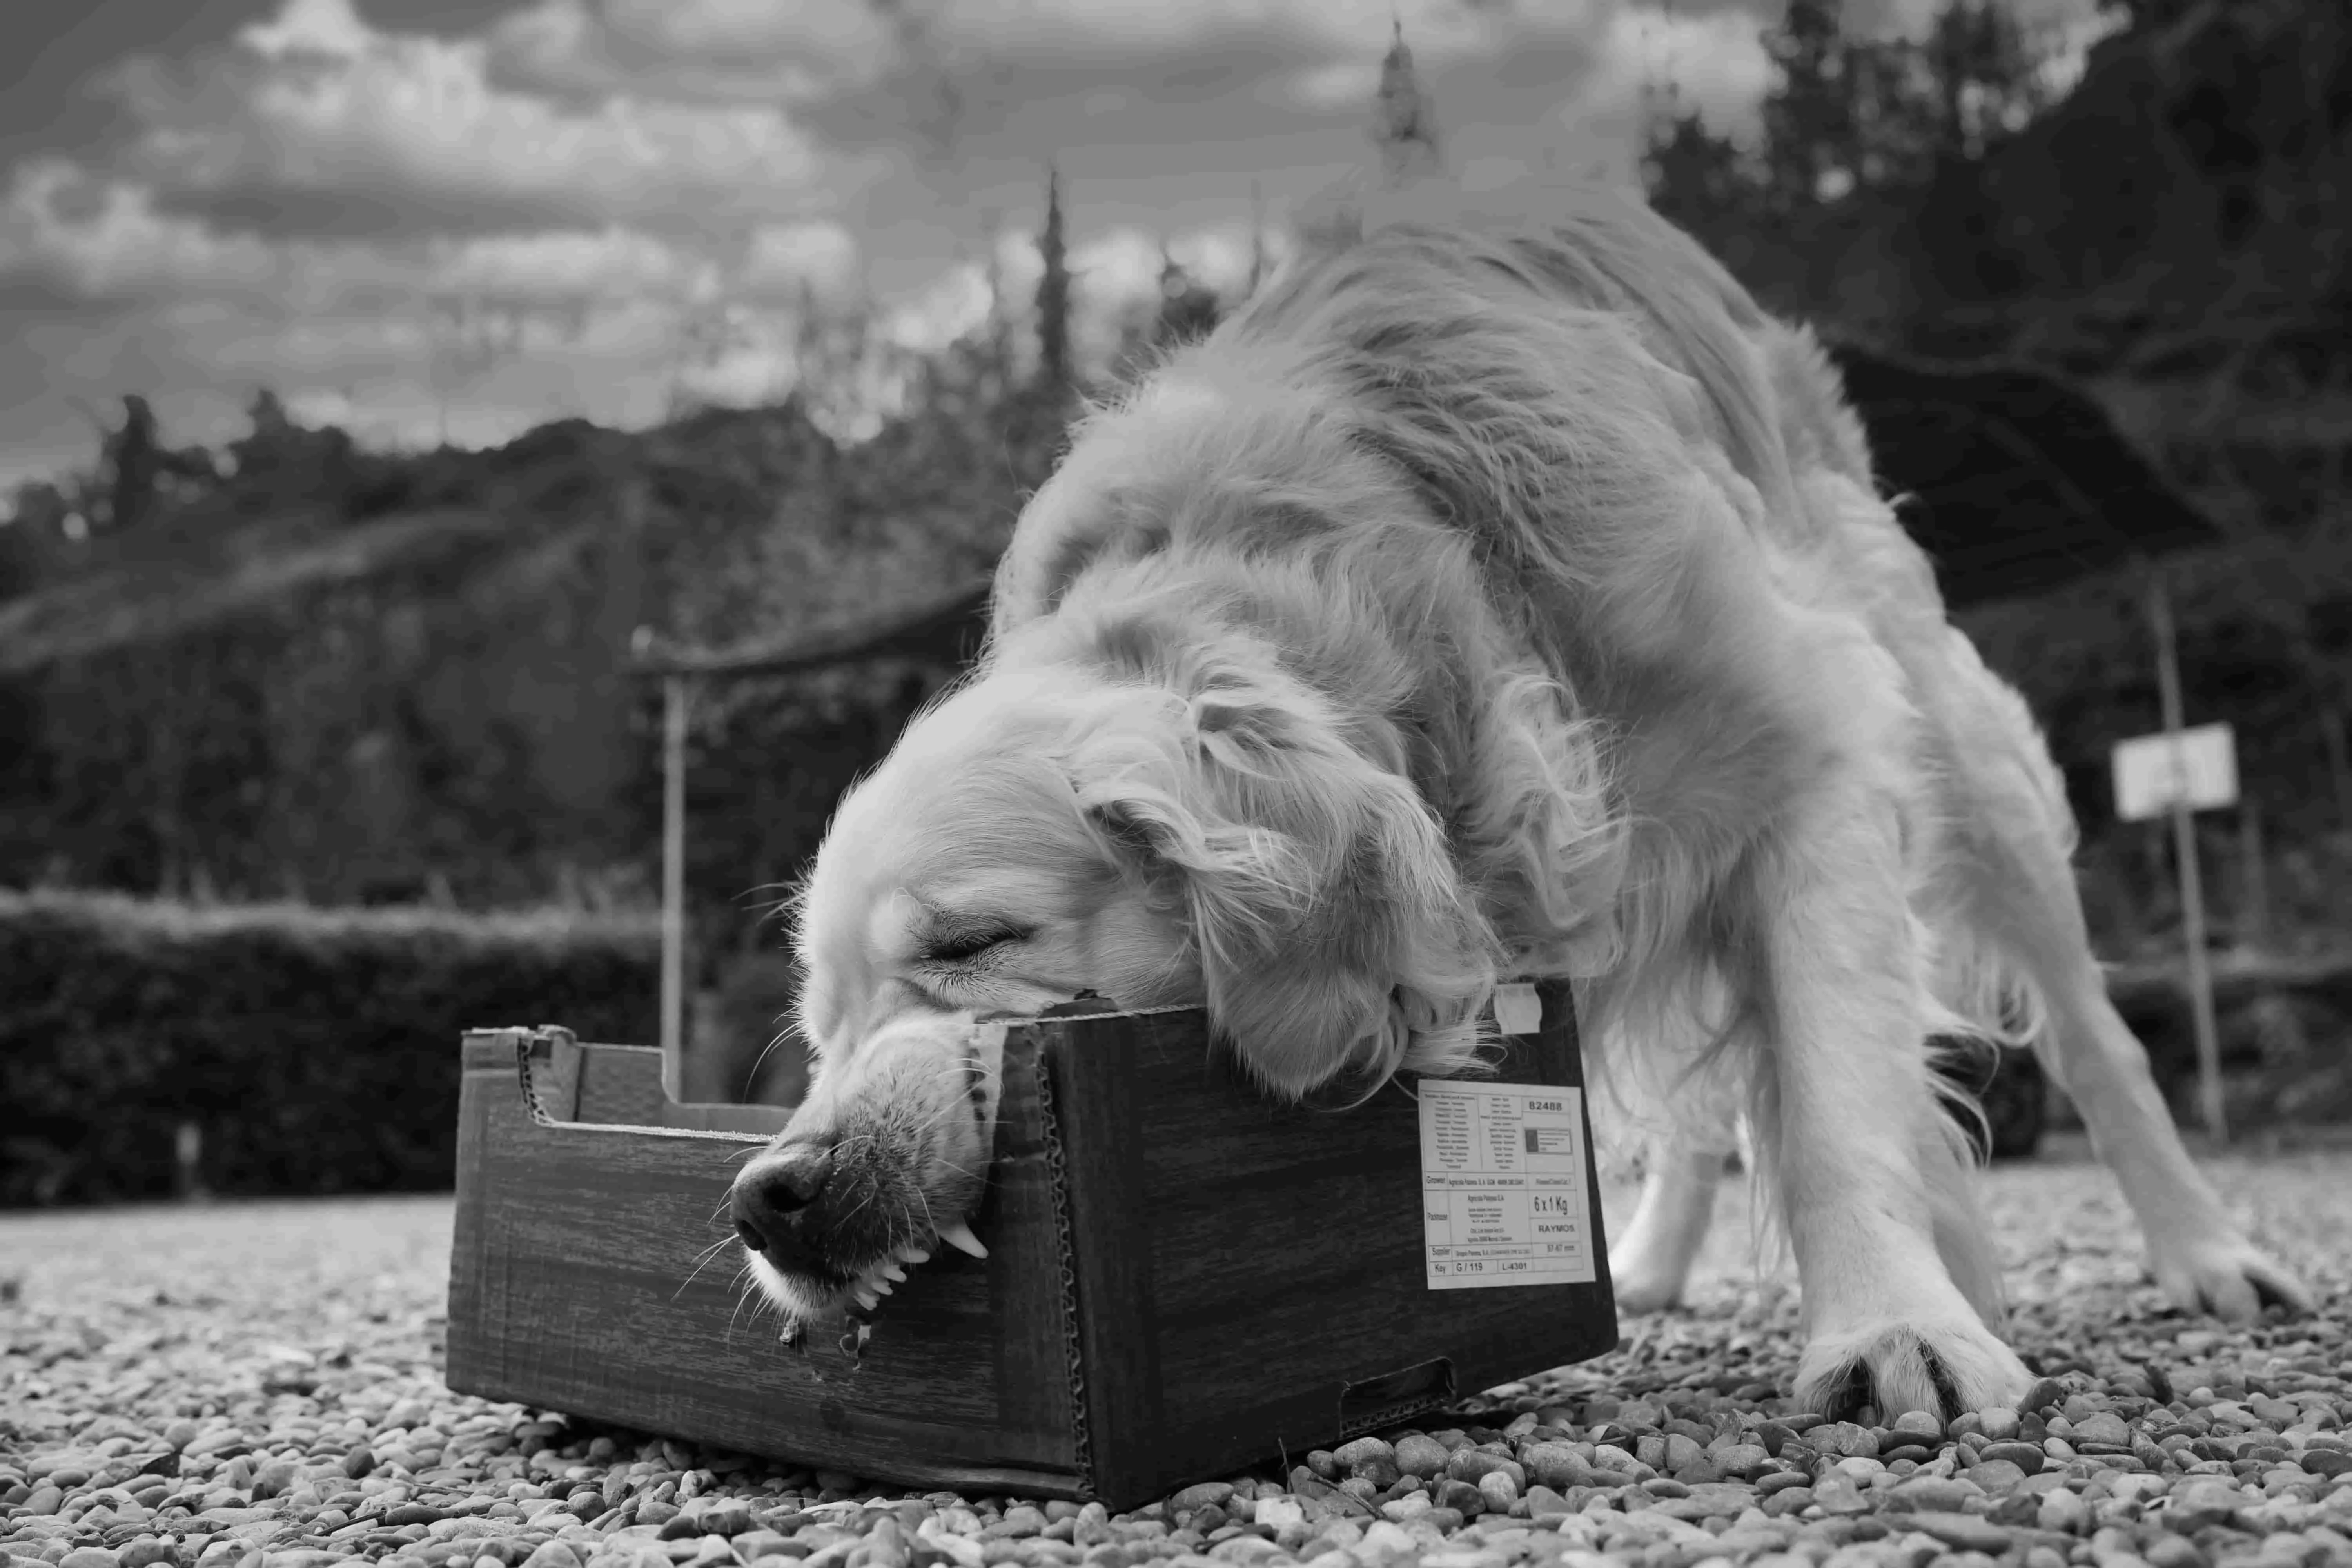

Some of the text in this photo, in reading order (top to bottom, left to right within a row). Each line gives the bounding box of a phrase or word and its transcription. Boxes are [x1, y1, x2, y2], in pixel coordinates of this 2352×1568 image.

[1534, 1196, 1567, 1215] 6 x 1 Kg
[1539, 1225, 1575, 1233] RAYMOS
[1434, 1263, 1446, 1274] Key
[1456, 1262, 1483, 1272] G / 119
